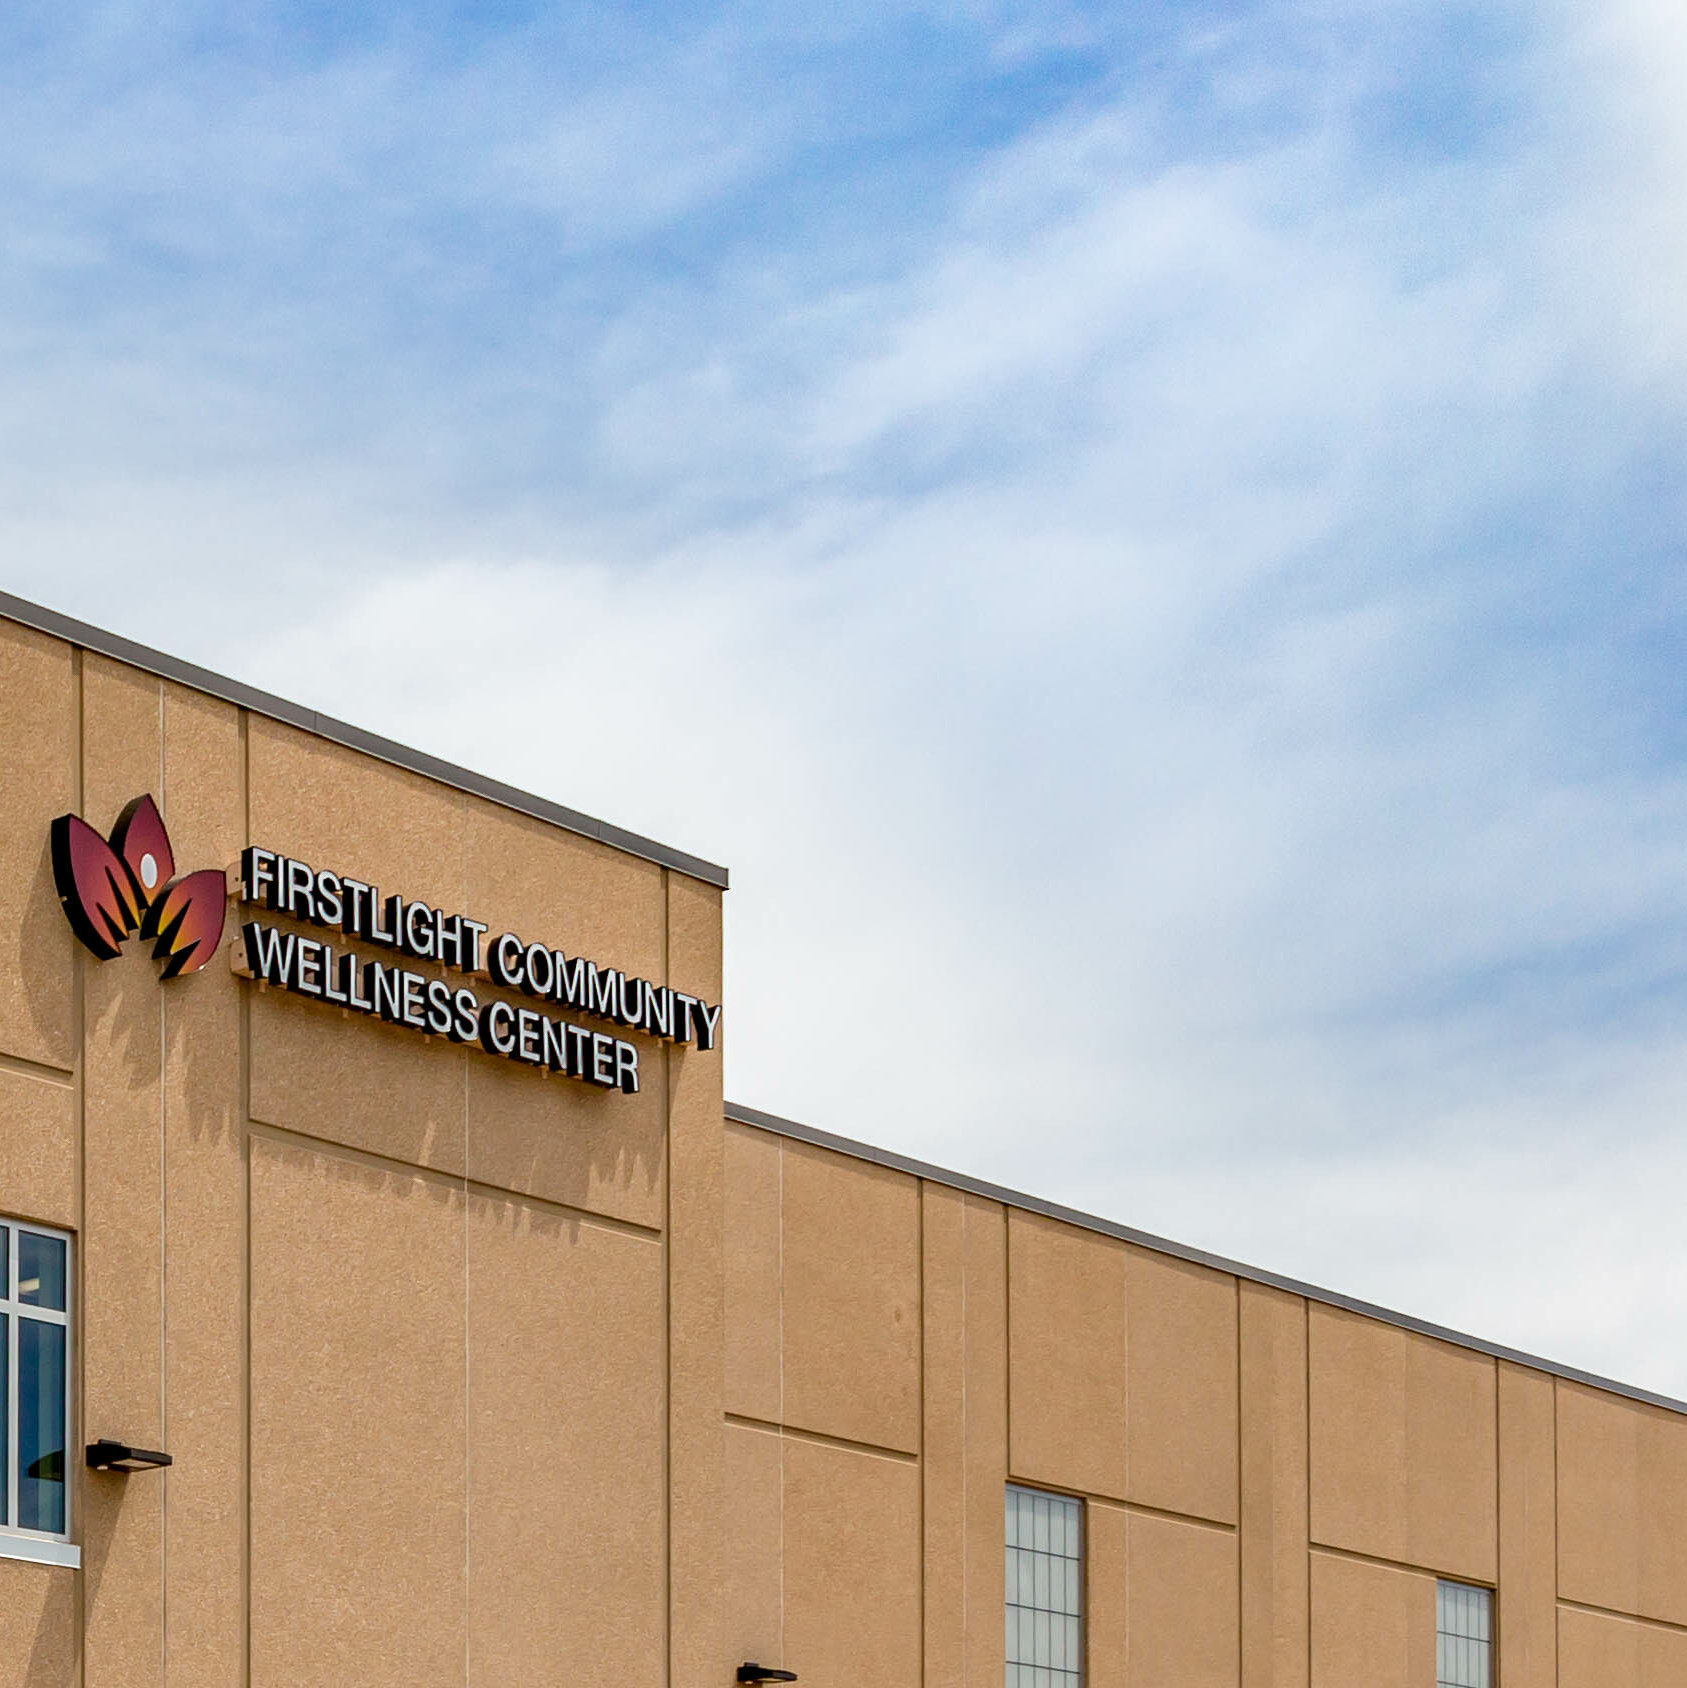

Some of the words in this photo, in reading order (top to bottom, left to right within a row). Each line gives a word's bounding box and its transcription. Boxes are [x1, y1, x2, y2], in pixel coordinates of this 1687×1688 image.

[247, 846, 487, 972] FIRSTLIGHT
[494, 932, 721, 1050] COMMUNITY
[248, 922, 480, 1042] WELLNESS
[486, 1000, 640, 1093] CENTER
